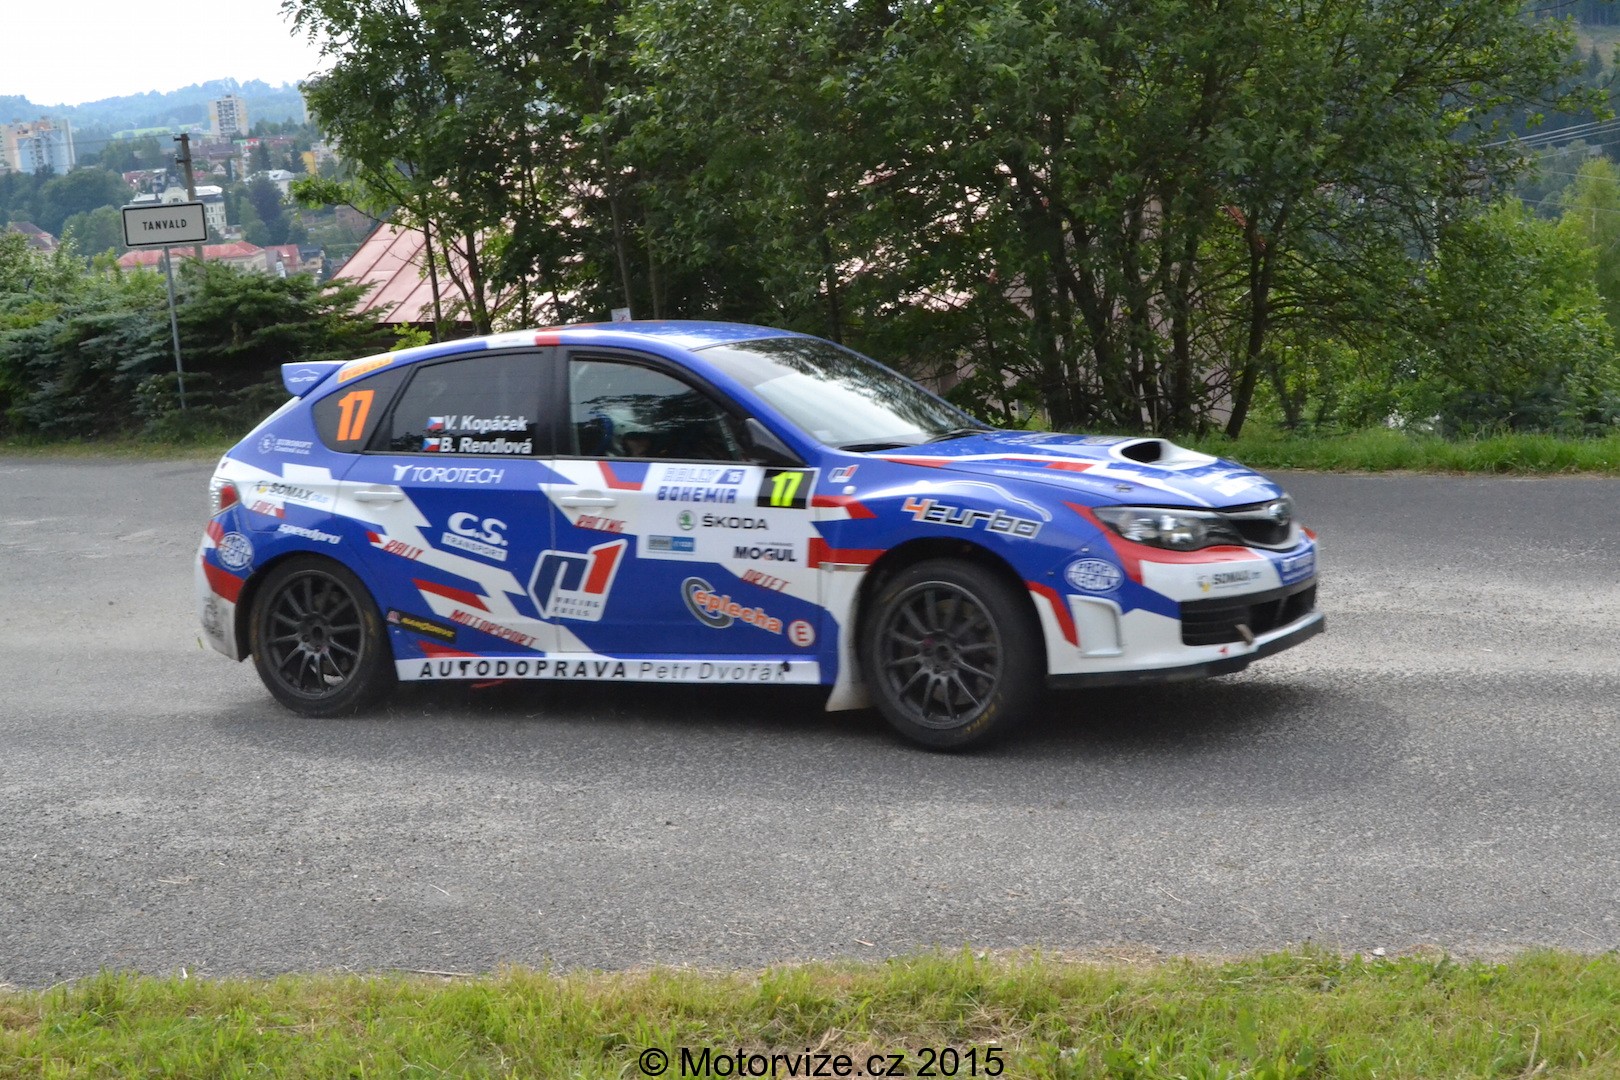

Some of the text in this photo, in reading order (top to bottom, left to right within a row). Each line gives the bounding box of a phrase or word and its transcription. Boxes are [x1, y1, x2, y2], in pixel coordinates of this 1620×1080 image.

[142, 219, 187, 231] TANVALD
[337, 389, 375, 441] 17
[443, 415, 528, 434] V. Kopáček
[439, 437, 533, 454] B. Rendlová
[410, 466, 505, 484] TOROTECH
[269, 482, 314, 500] SOMAX
[657, 485, 738, 504] BOHEMIA
[769, 471, 804, 508] 17
[702, 513, 769, 530] ŠKODA
[383, 540, 424, 561] RALLY
[445, 534, 504, 559] TRANSPORT
[734, 546, 797, 562] MOGUL
[742, 569, 791, 593] DRIFT
[450, 609, 540, 647] MOTORSPORT
[419, 660, 788, 682] AUTODOPRAVA Petr Dvořák
